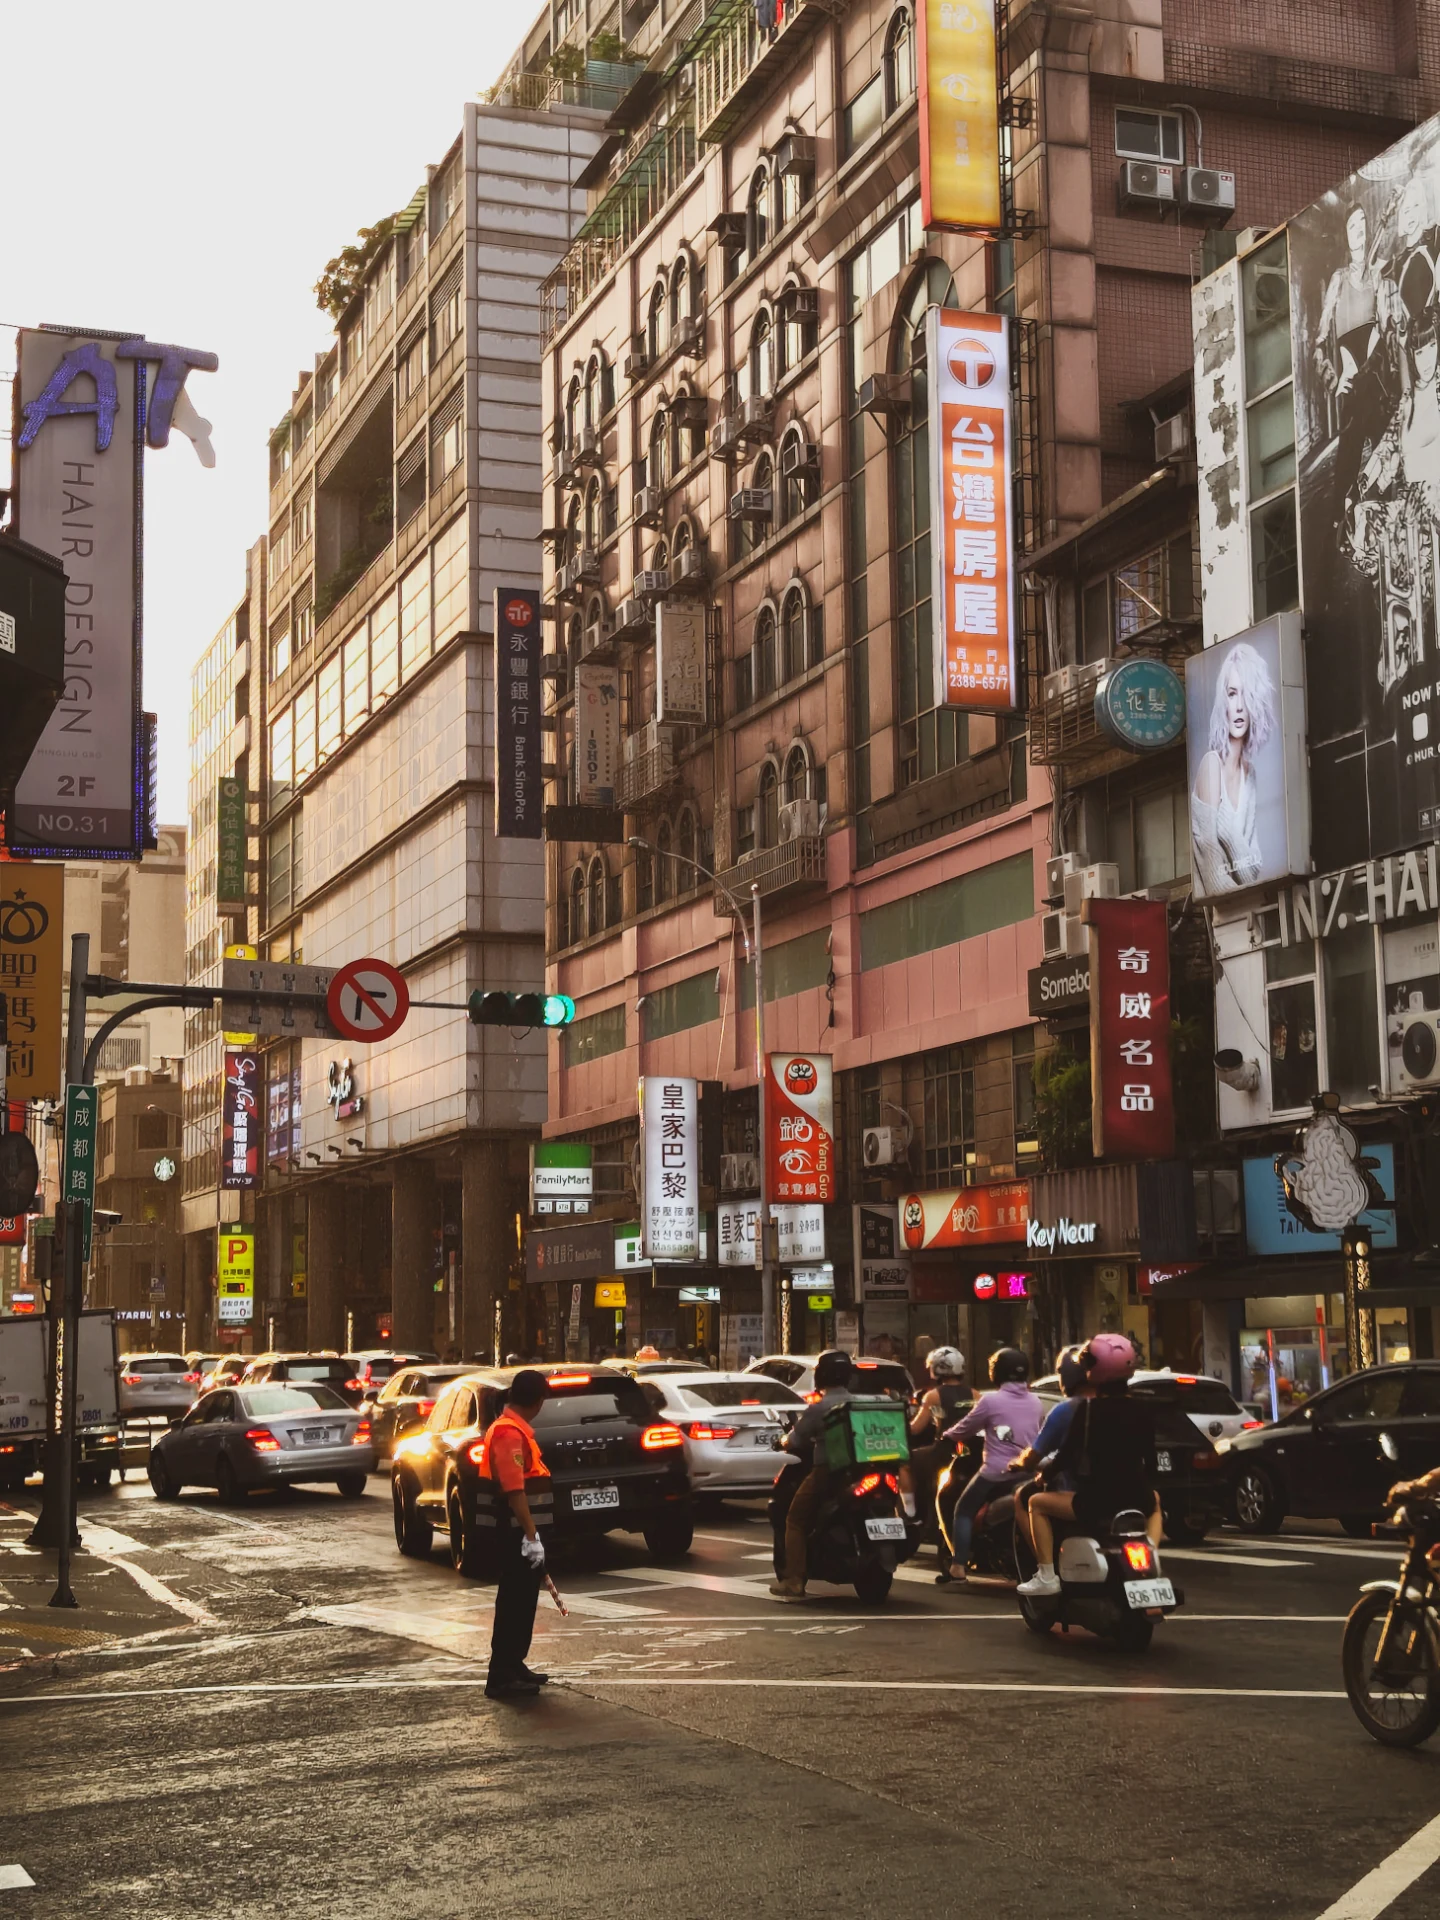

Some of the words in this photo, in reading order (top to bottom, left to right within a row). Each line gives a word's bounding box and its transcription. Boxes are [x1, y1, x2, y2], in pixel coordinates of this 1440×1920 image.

[17, 340, 219, 452] AT
[61, 461, 95, 557] HAIR
[951, 417, 999, 635] 台灣房屋
[59, 582, 95, 733] DESIGN
[509, 633, 529, 726] 永豐銀行
[949, 673, 1008, 690] 2388-6577
[1402, 685, 1432, 710] NOW
[514, 736, 526, 769] Bank
[56, 775, 96, 798] 2F
[38, 814, 109, 834] NO.31
[1365, 844, 1439, 924] HAI
[1040, 968, 1090, 1001] Somebo
[1116, 946, 1155, 1112] 奇威名品
[71, 1107, 90, 1190] 成都路
[661, 1083, 687, 1199] 皇家巴黎
[816, 1142, 829, 1172] Yang
[535, 1174, 591, 1187] FamilyMart
[819, 1174, 830, 1199] Guo
[651, 1206, 695, 1217] 舒壓按摩
[651, 1218, 696, 1229] マッサージ
[228, 1239, 248, 1264] P
[652, 1242, 695, 1254] Massage
[863, 1422, 896, 1437] Uber
[864, 1437, 898, 1451] Eats
